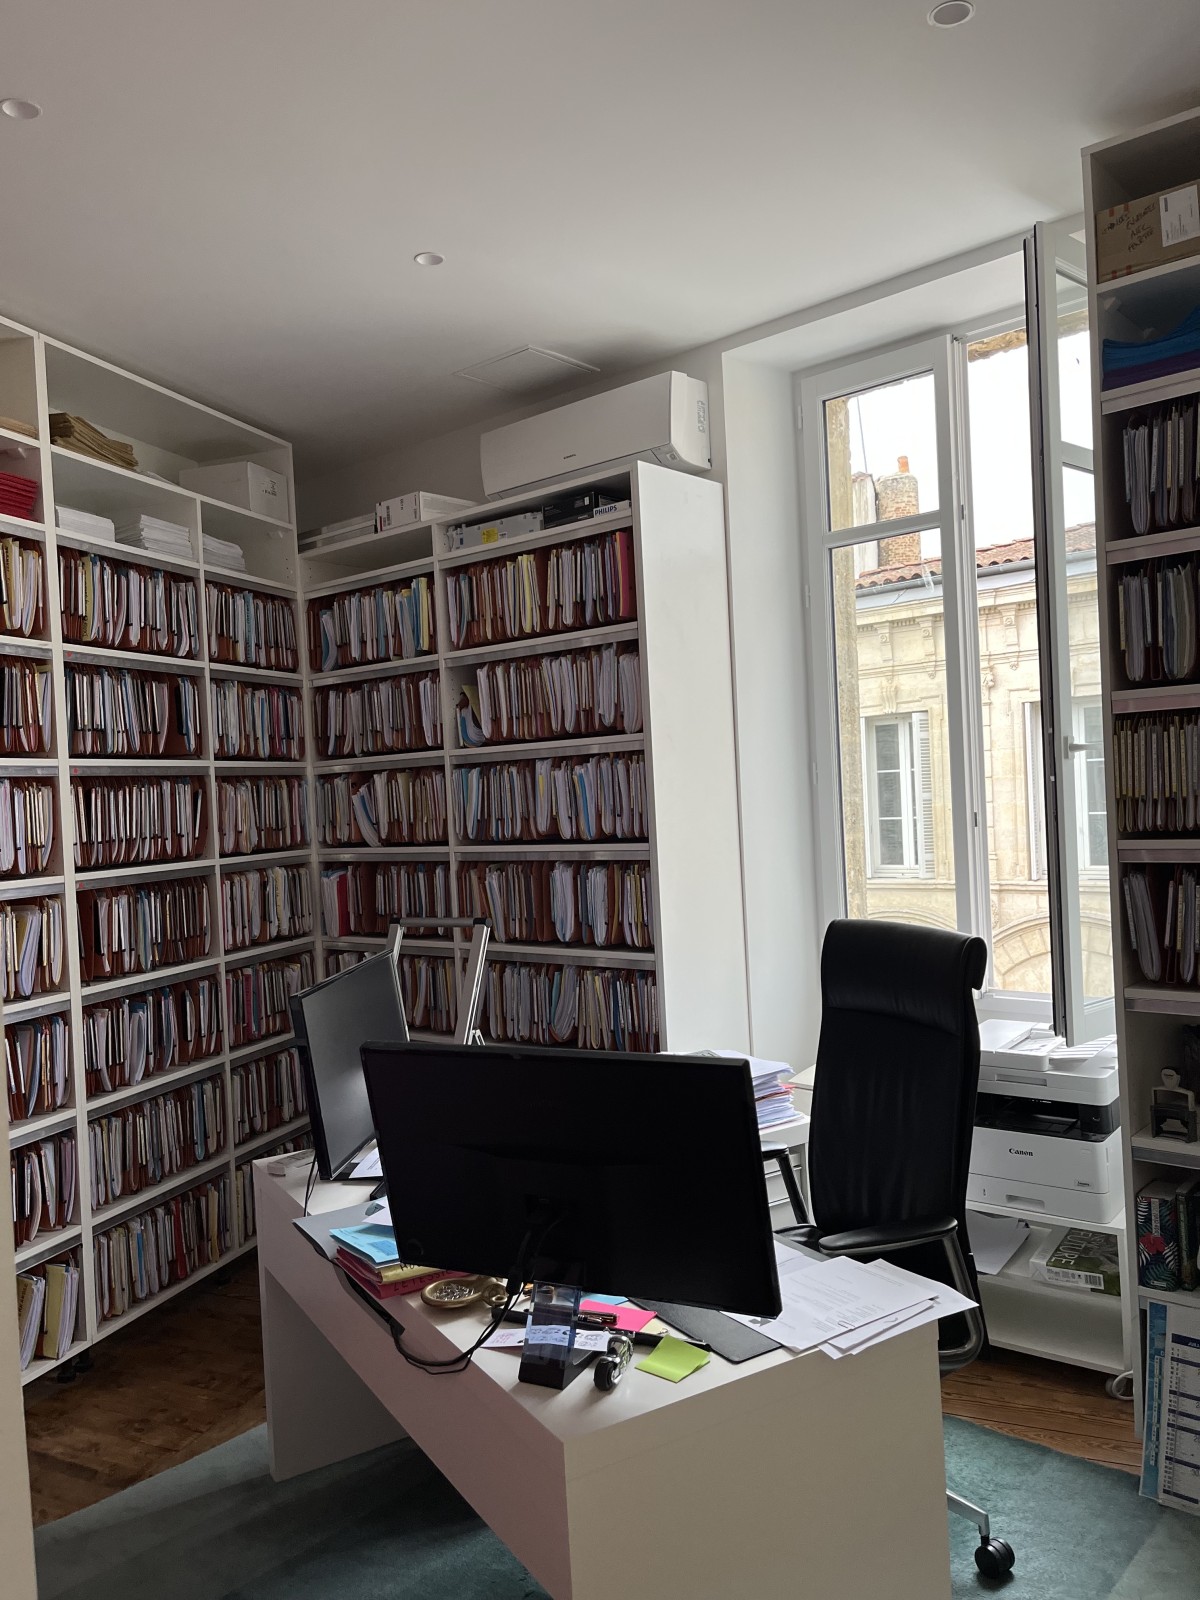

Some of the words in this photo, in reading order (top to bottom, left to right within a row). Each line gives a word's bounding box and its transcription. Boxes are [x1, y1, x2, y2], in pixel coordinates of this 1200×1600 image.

[595, 505, 618, 517] PHILIPS
[1009, 1147, 1034, 1157] Canon
[1051, 1230, 1092, 1265] FUTURE
